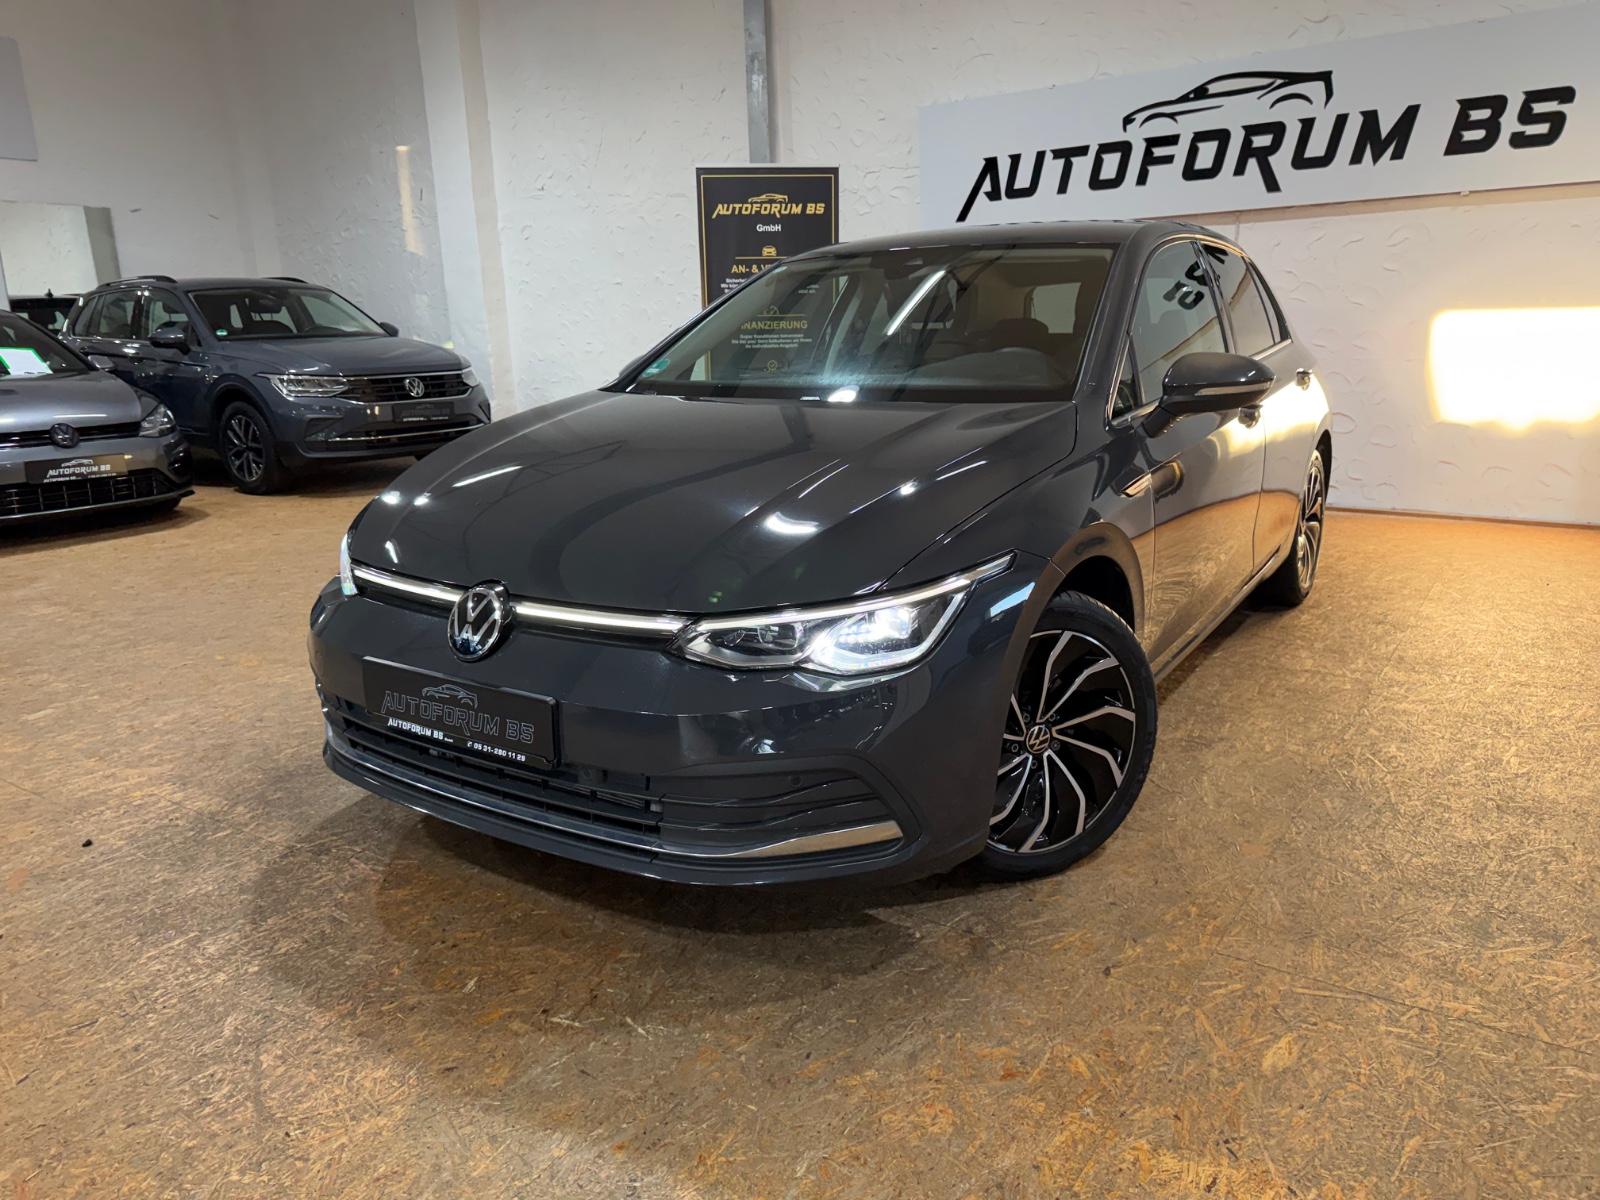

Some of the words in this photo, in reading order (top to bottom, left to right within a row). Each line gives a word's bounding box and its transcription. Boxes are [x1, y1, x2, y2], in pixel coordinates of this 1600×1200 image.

[956, 104, 1420, 222] AUTOFORUM
[1443, 86, 1576, 157] BS
[711, 203, 802, 219] AUTOFORUM
[806, 203, 825, 214] BS
[756, 224, 782, 232] GmbH
[731, 264, 749, 273] AN-
[751, 264, 759, 273] &
[741, 320, 808, 329] NANZIERUNG
[46, 466, 99, 478] AUTOFORUM
[381, 690, 500, 737] AUTOFORUM
[505, 719, 535, 744] BS
[387, 717, 432, 737] AUTOFORUM
[433, 730, 444, 740] BS
